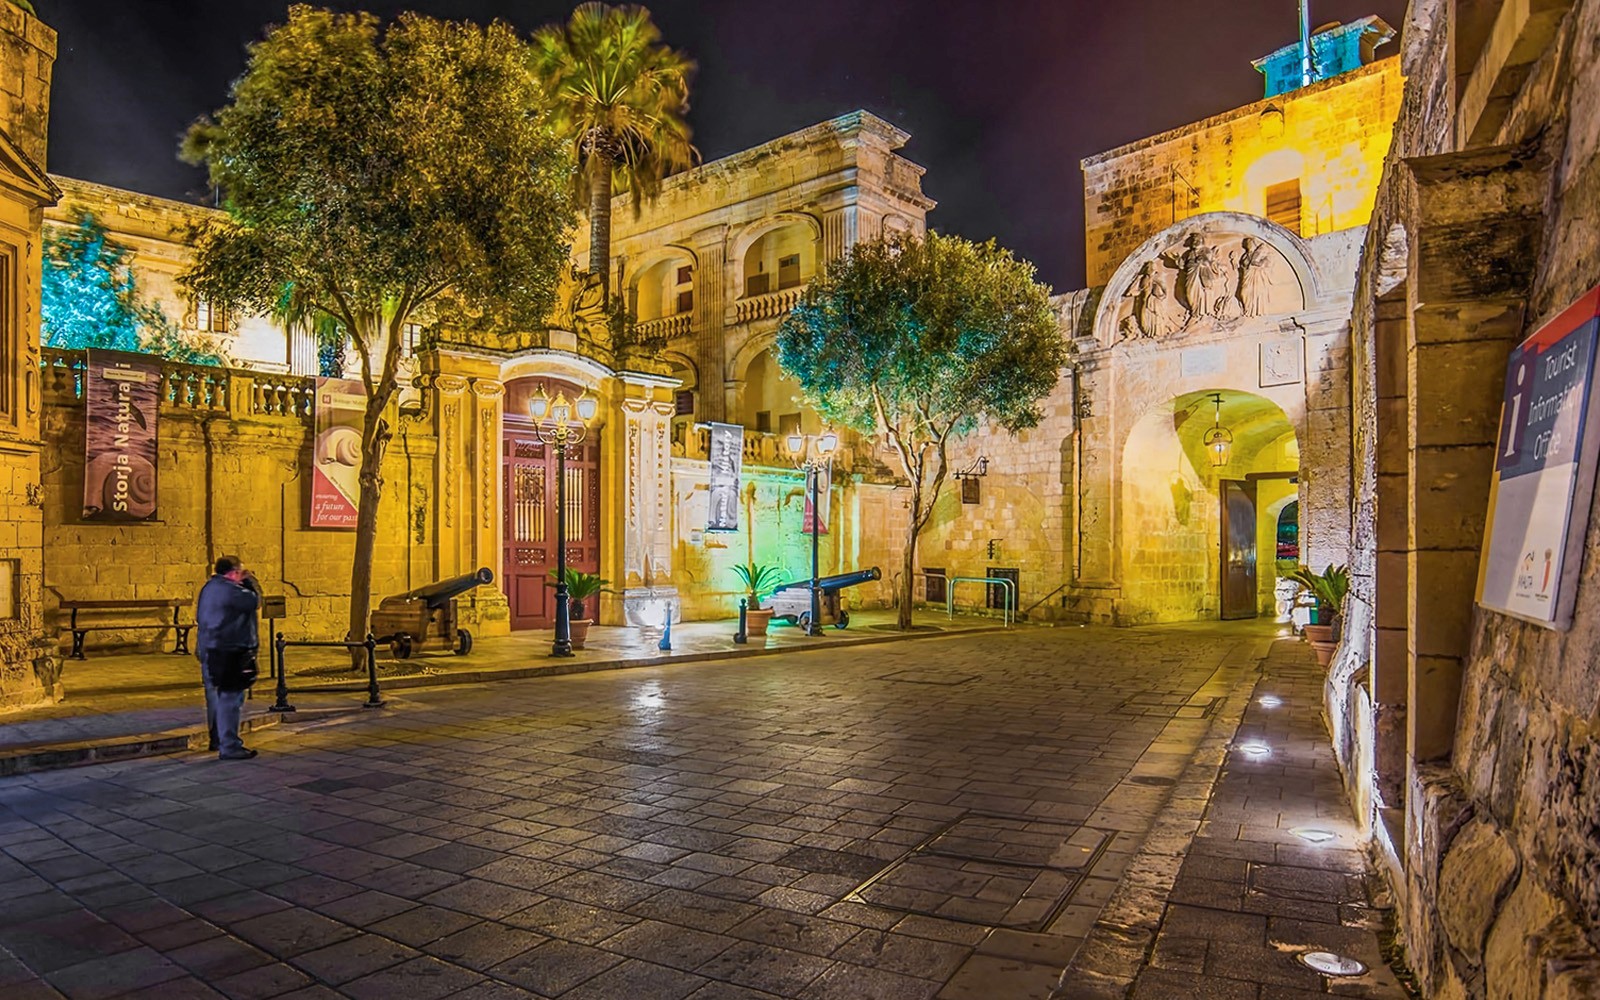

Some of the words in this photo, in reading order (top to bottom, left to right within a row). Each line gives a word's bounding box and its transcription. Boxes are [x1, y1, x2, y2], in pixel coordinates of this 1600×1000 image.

[1544, 340, 1577, 381] Tourist
[115, 362, 131, 448] Naturai
[1527, 382, 1583, 426] Information
[721, 430, 732, 473] History
[1534, 429, 1561, 460] Office
[113, 454, 132, 512] Storja
[315, 511, 329, 523] for
[320, 500, 344, 511] future
